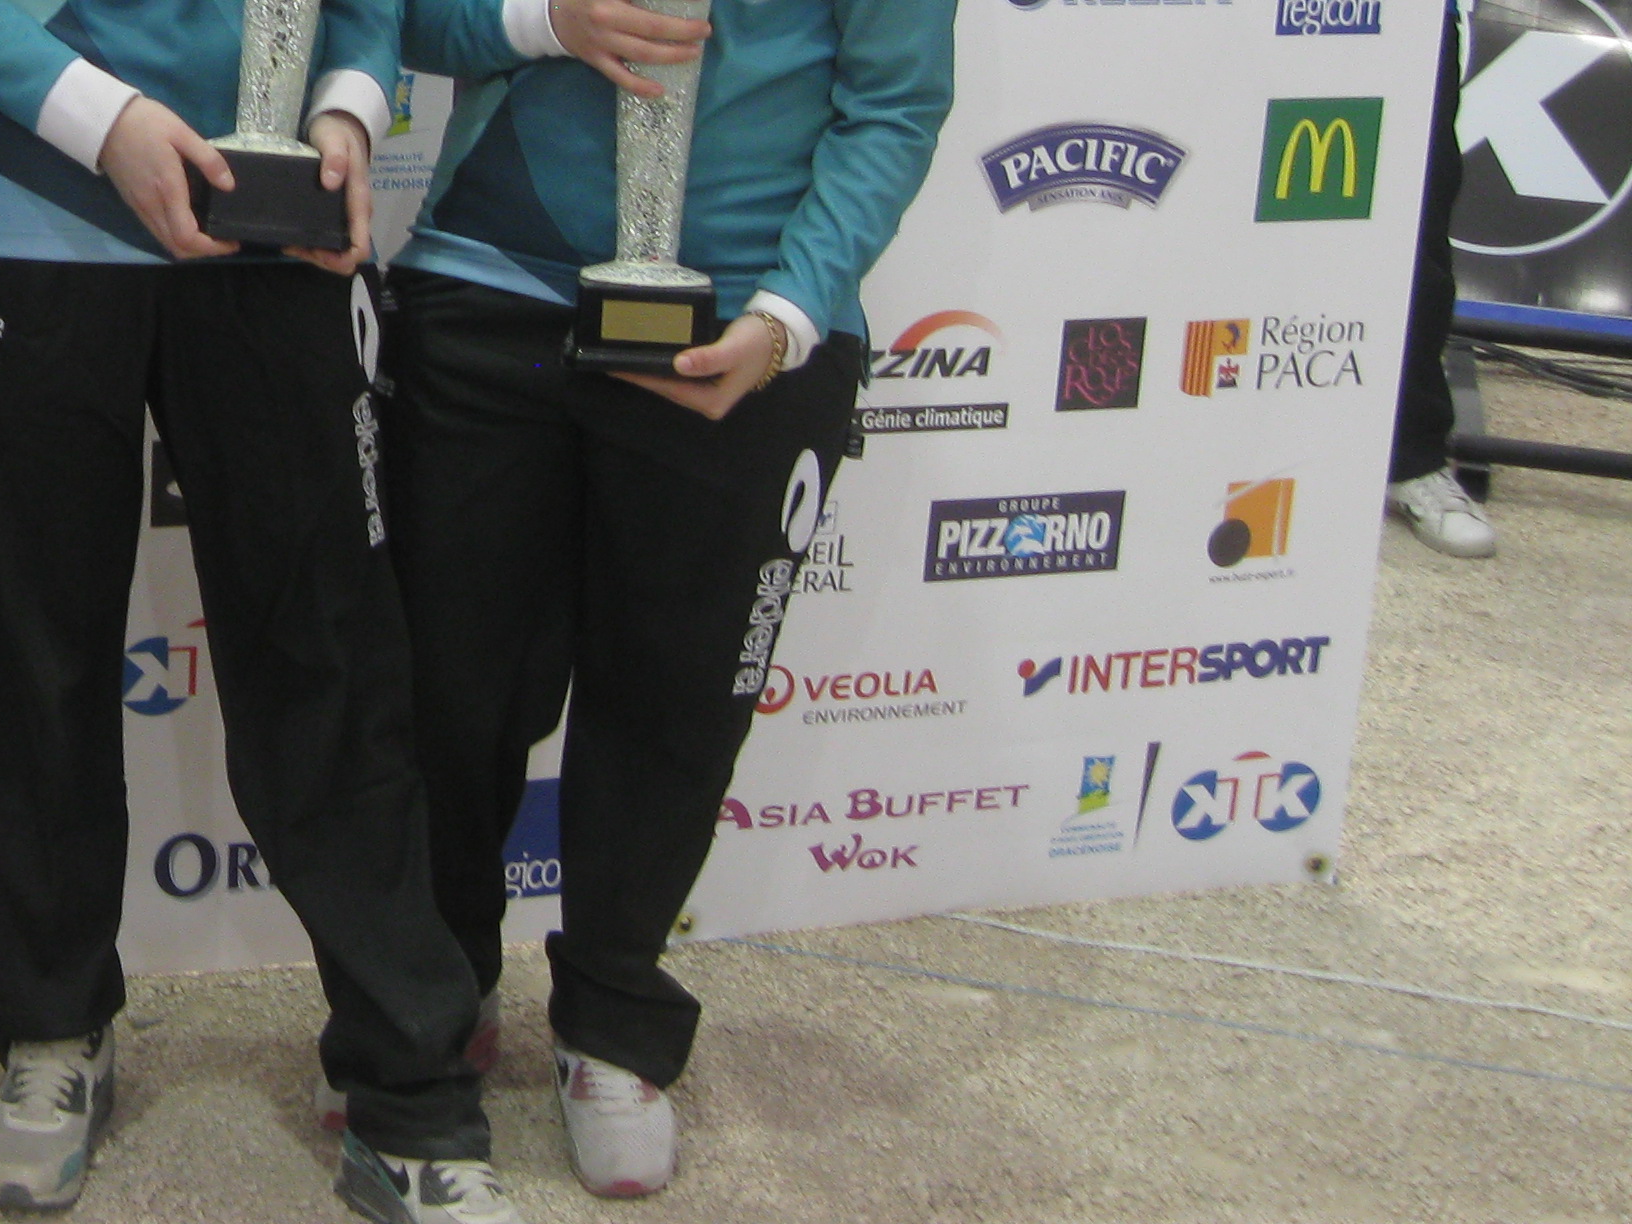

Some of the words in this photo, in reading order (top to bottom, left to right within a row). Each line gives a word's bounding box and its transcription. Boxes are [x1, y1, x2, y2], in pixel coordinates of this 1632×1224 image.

[1000, 138, 1161, 190] PACIFIC
[1261, 314, 1365, 353] Région
[1256, 347, 1363, 390] PACA
[861, 407, 912, 431] Génie
[915, 404, 1004, 430] climatique
[998, 496, 1060, 514] GROUPE
[934, 552, 1108, 576] ENVIRONNEMENT
[1068, 635, 1330, 695] INTERSPORT
[802, 668, 939, 702] VEOLIA
[802, 699, 968, 726] ENVIRONNEMENT
[713, 796, 831, 838] ASIA
[845, 784, 1031, 822] BUFFET
